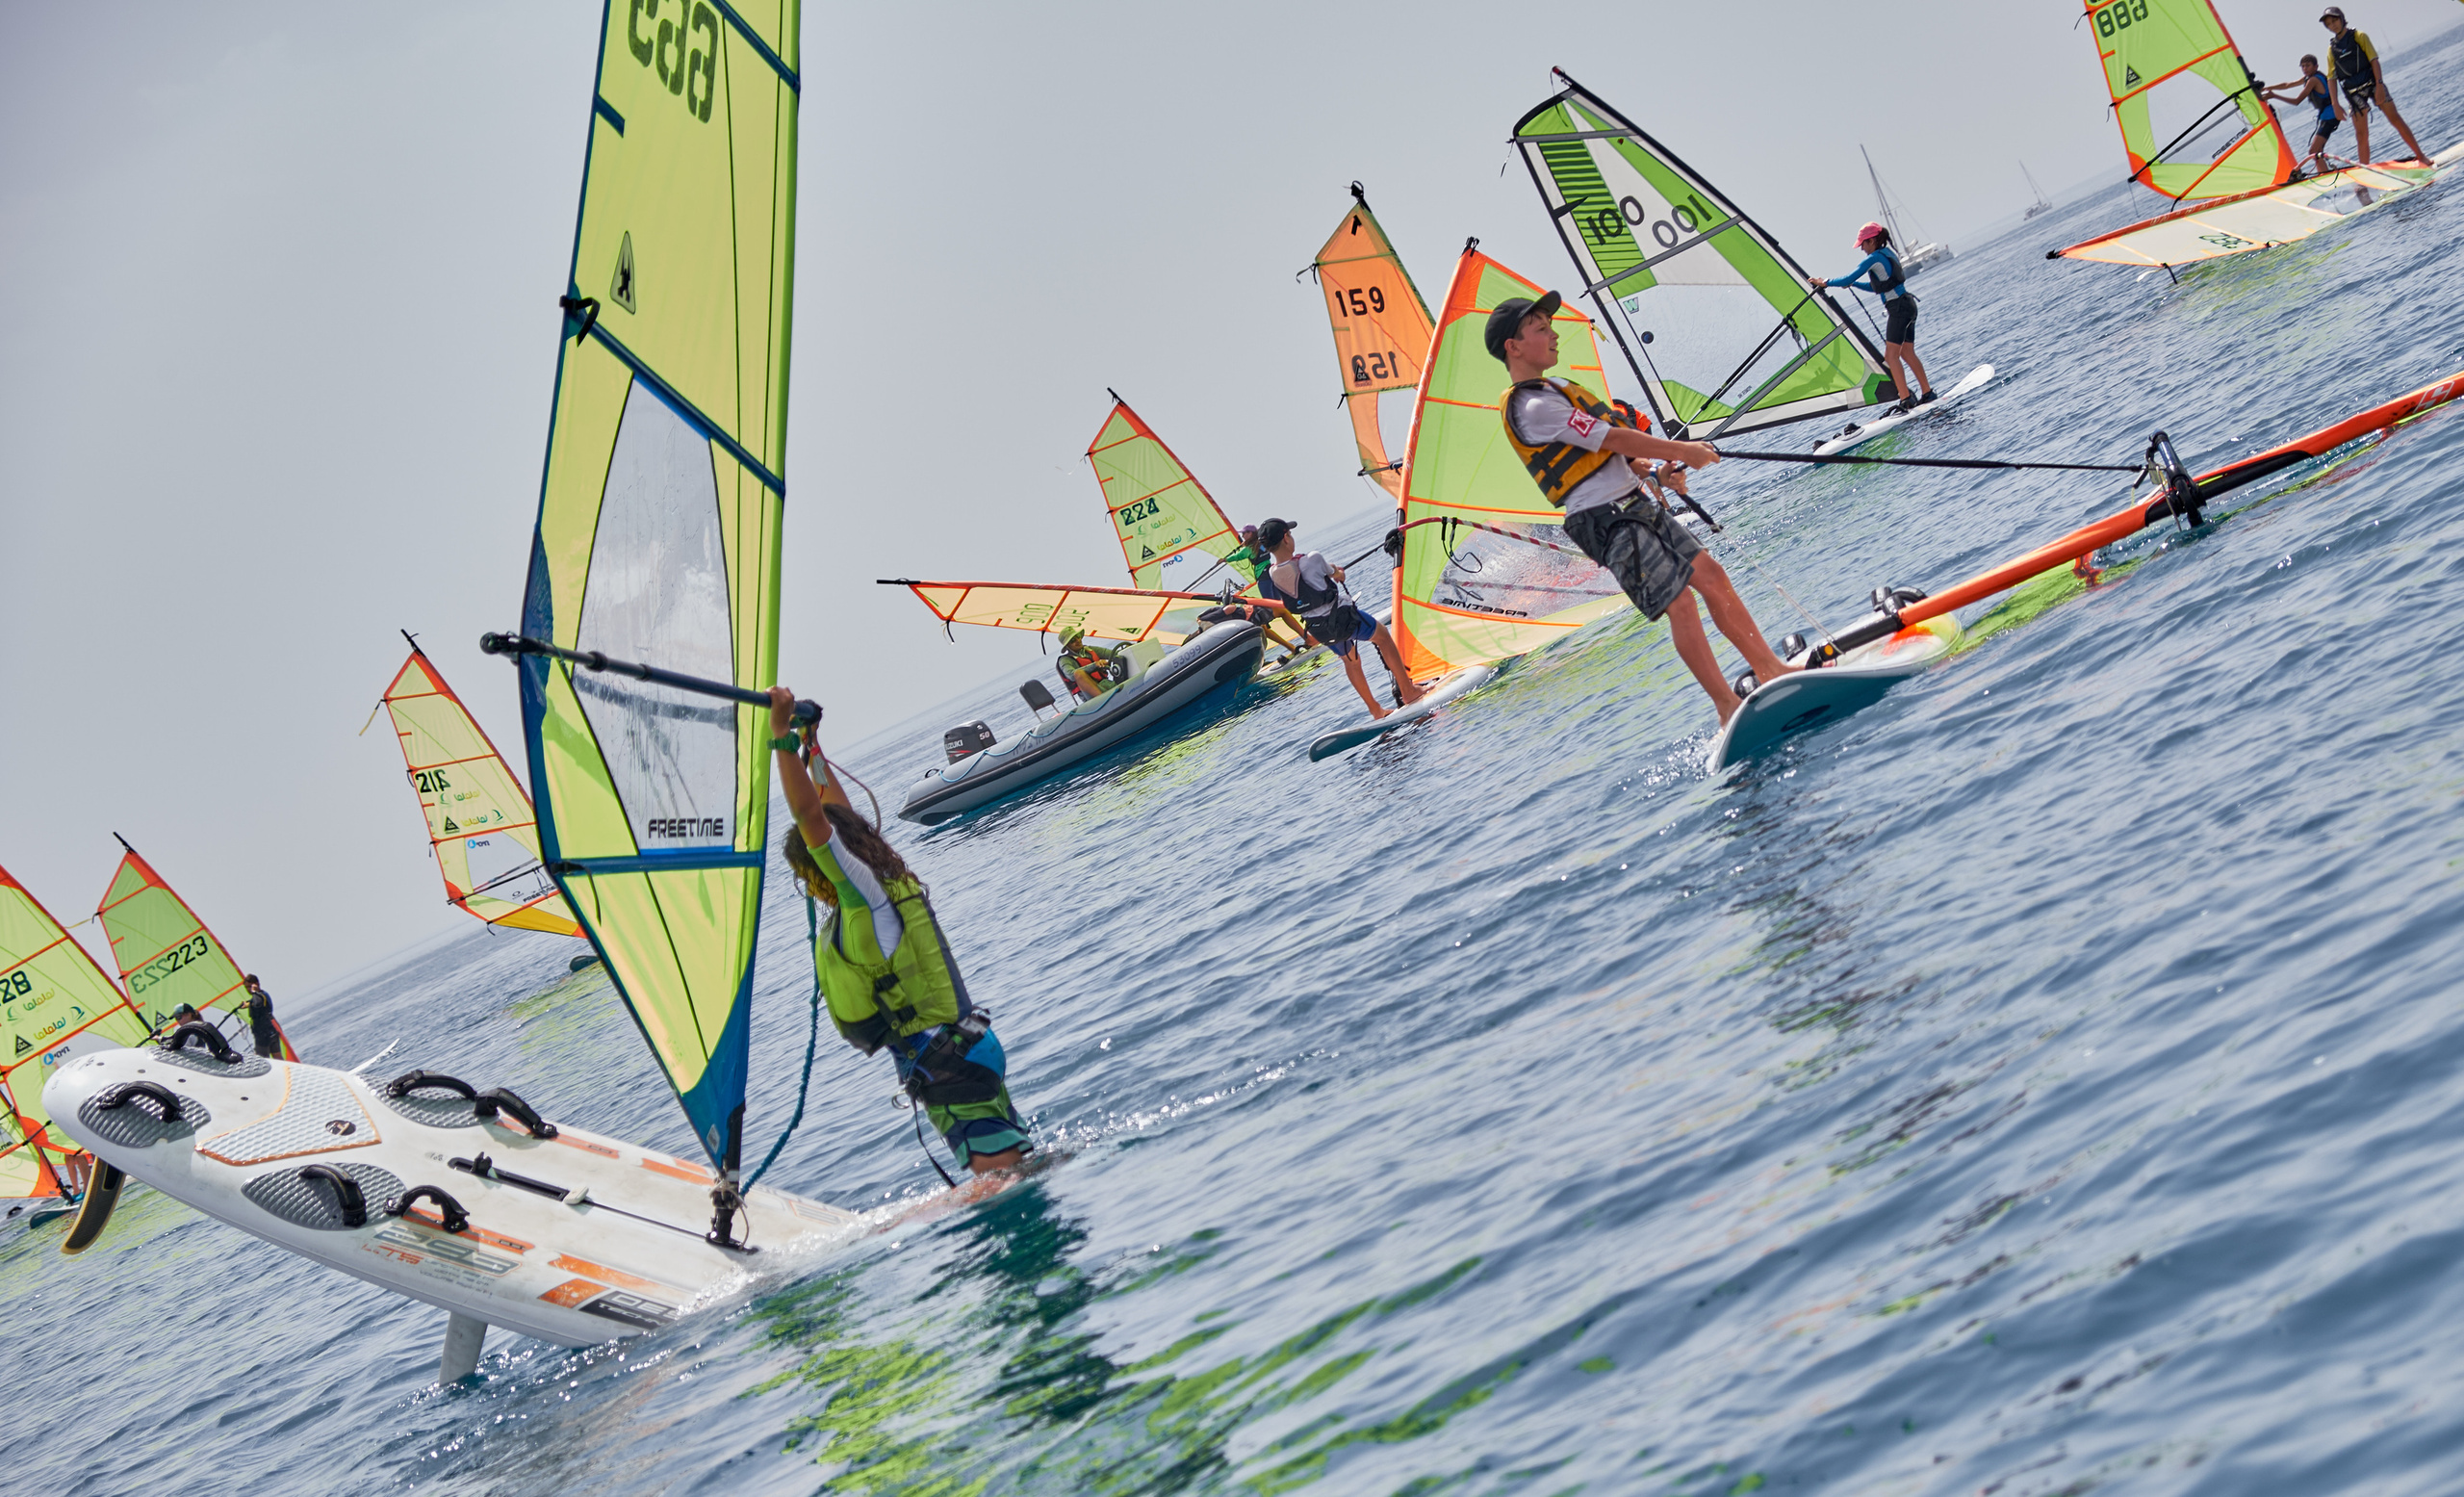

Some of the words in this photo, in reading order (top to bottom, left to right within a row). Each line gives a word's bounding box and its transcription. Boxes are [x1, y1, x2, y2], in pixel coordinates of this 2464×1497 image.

[1335, 286, 1385, 318] 159
[1120, 497, 1160, 527] 224
[1171, 644, 1202, 669] 53099
[979, 731, 990, 741] 50
[648, 817, 724, 839] FREETIME
[167, 935, 208, 973] 223
[0, 969, 33, 1005] 28
